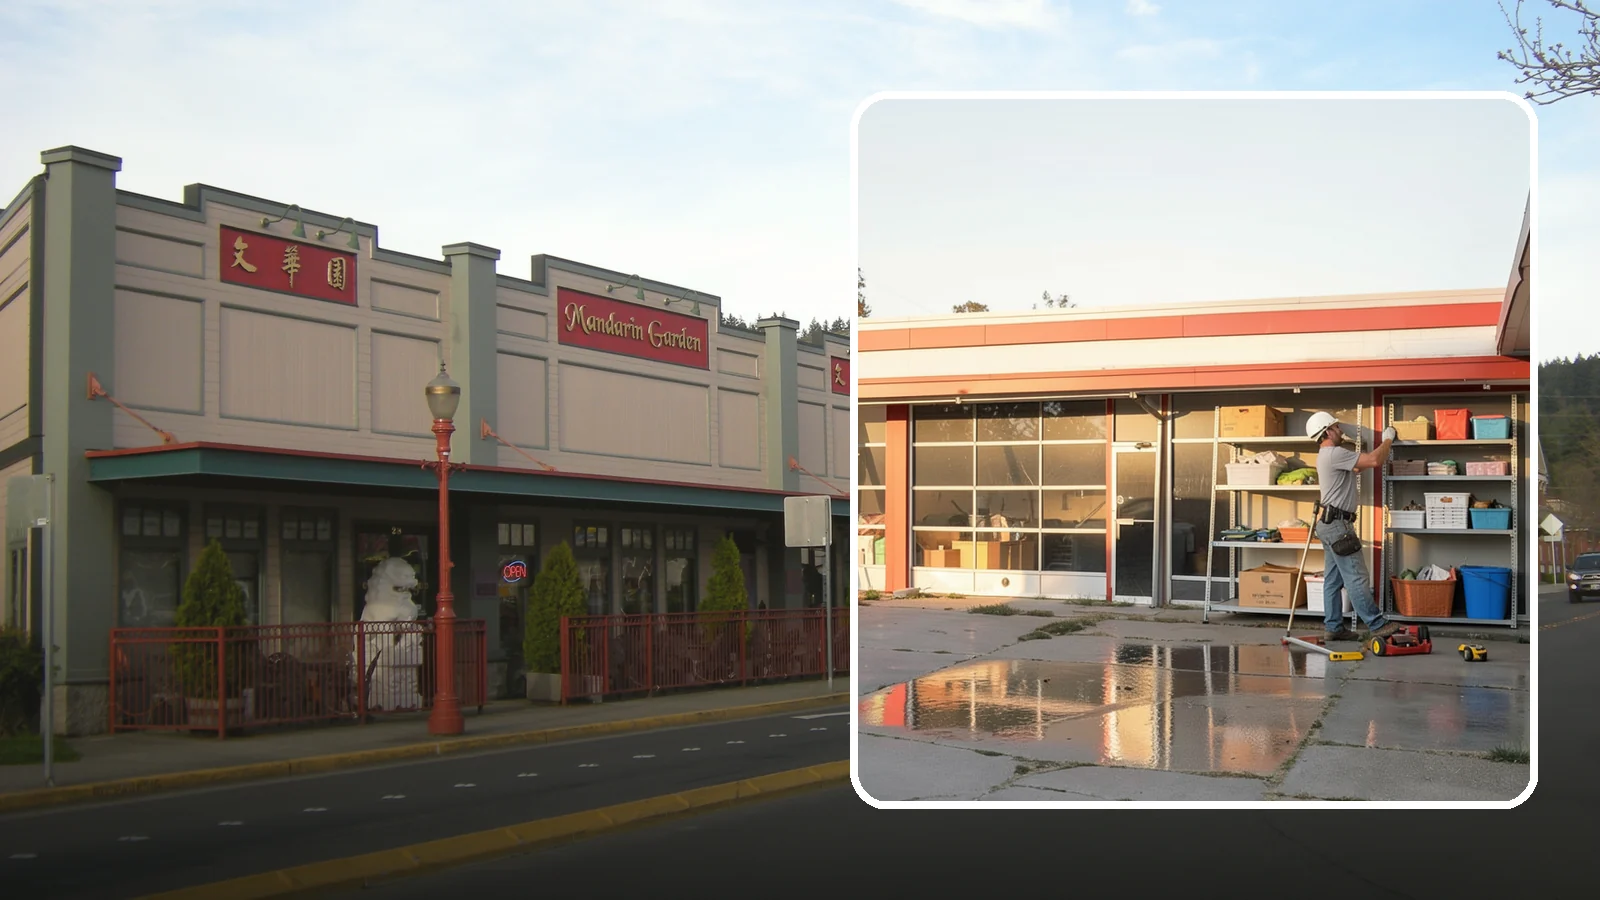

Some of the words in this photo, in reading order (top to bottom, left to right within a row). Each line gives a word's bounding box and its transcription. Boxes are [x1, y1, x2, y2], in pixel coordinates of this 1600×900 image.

[231, 235, 346, 291] 文華園
[564, 302, 644, 341] Mandarin
[648, 320, 702, 352] Garden
[503, 565, 527, 578] OPEN
